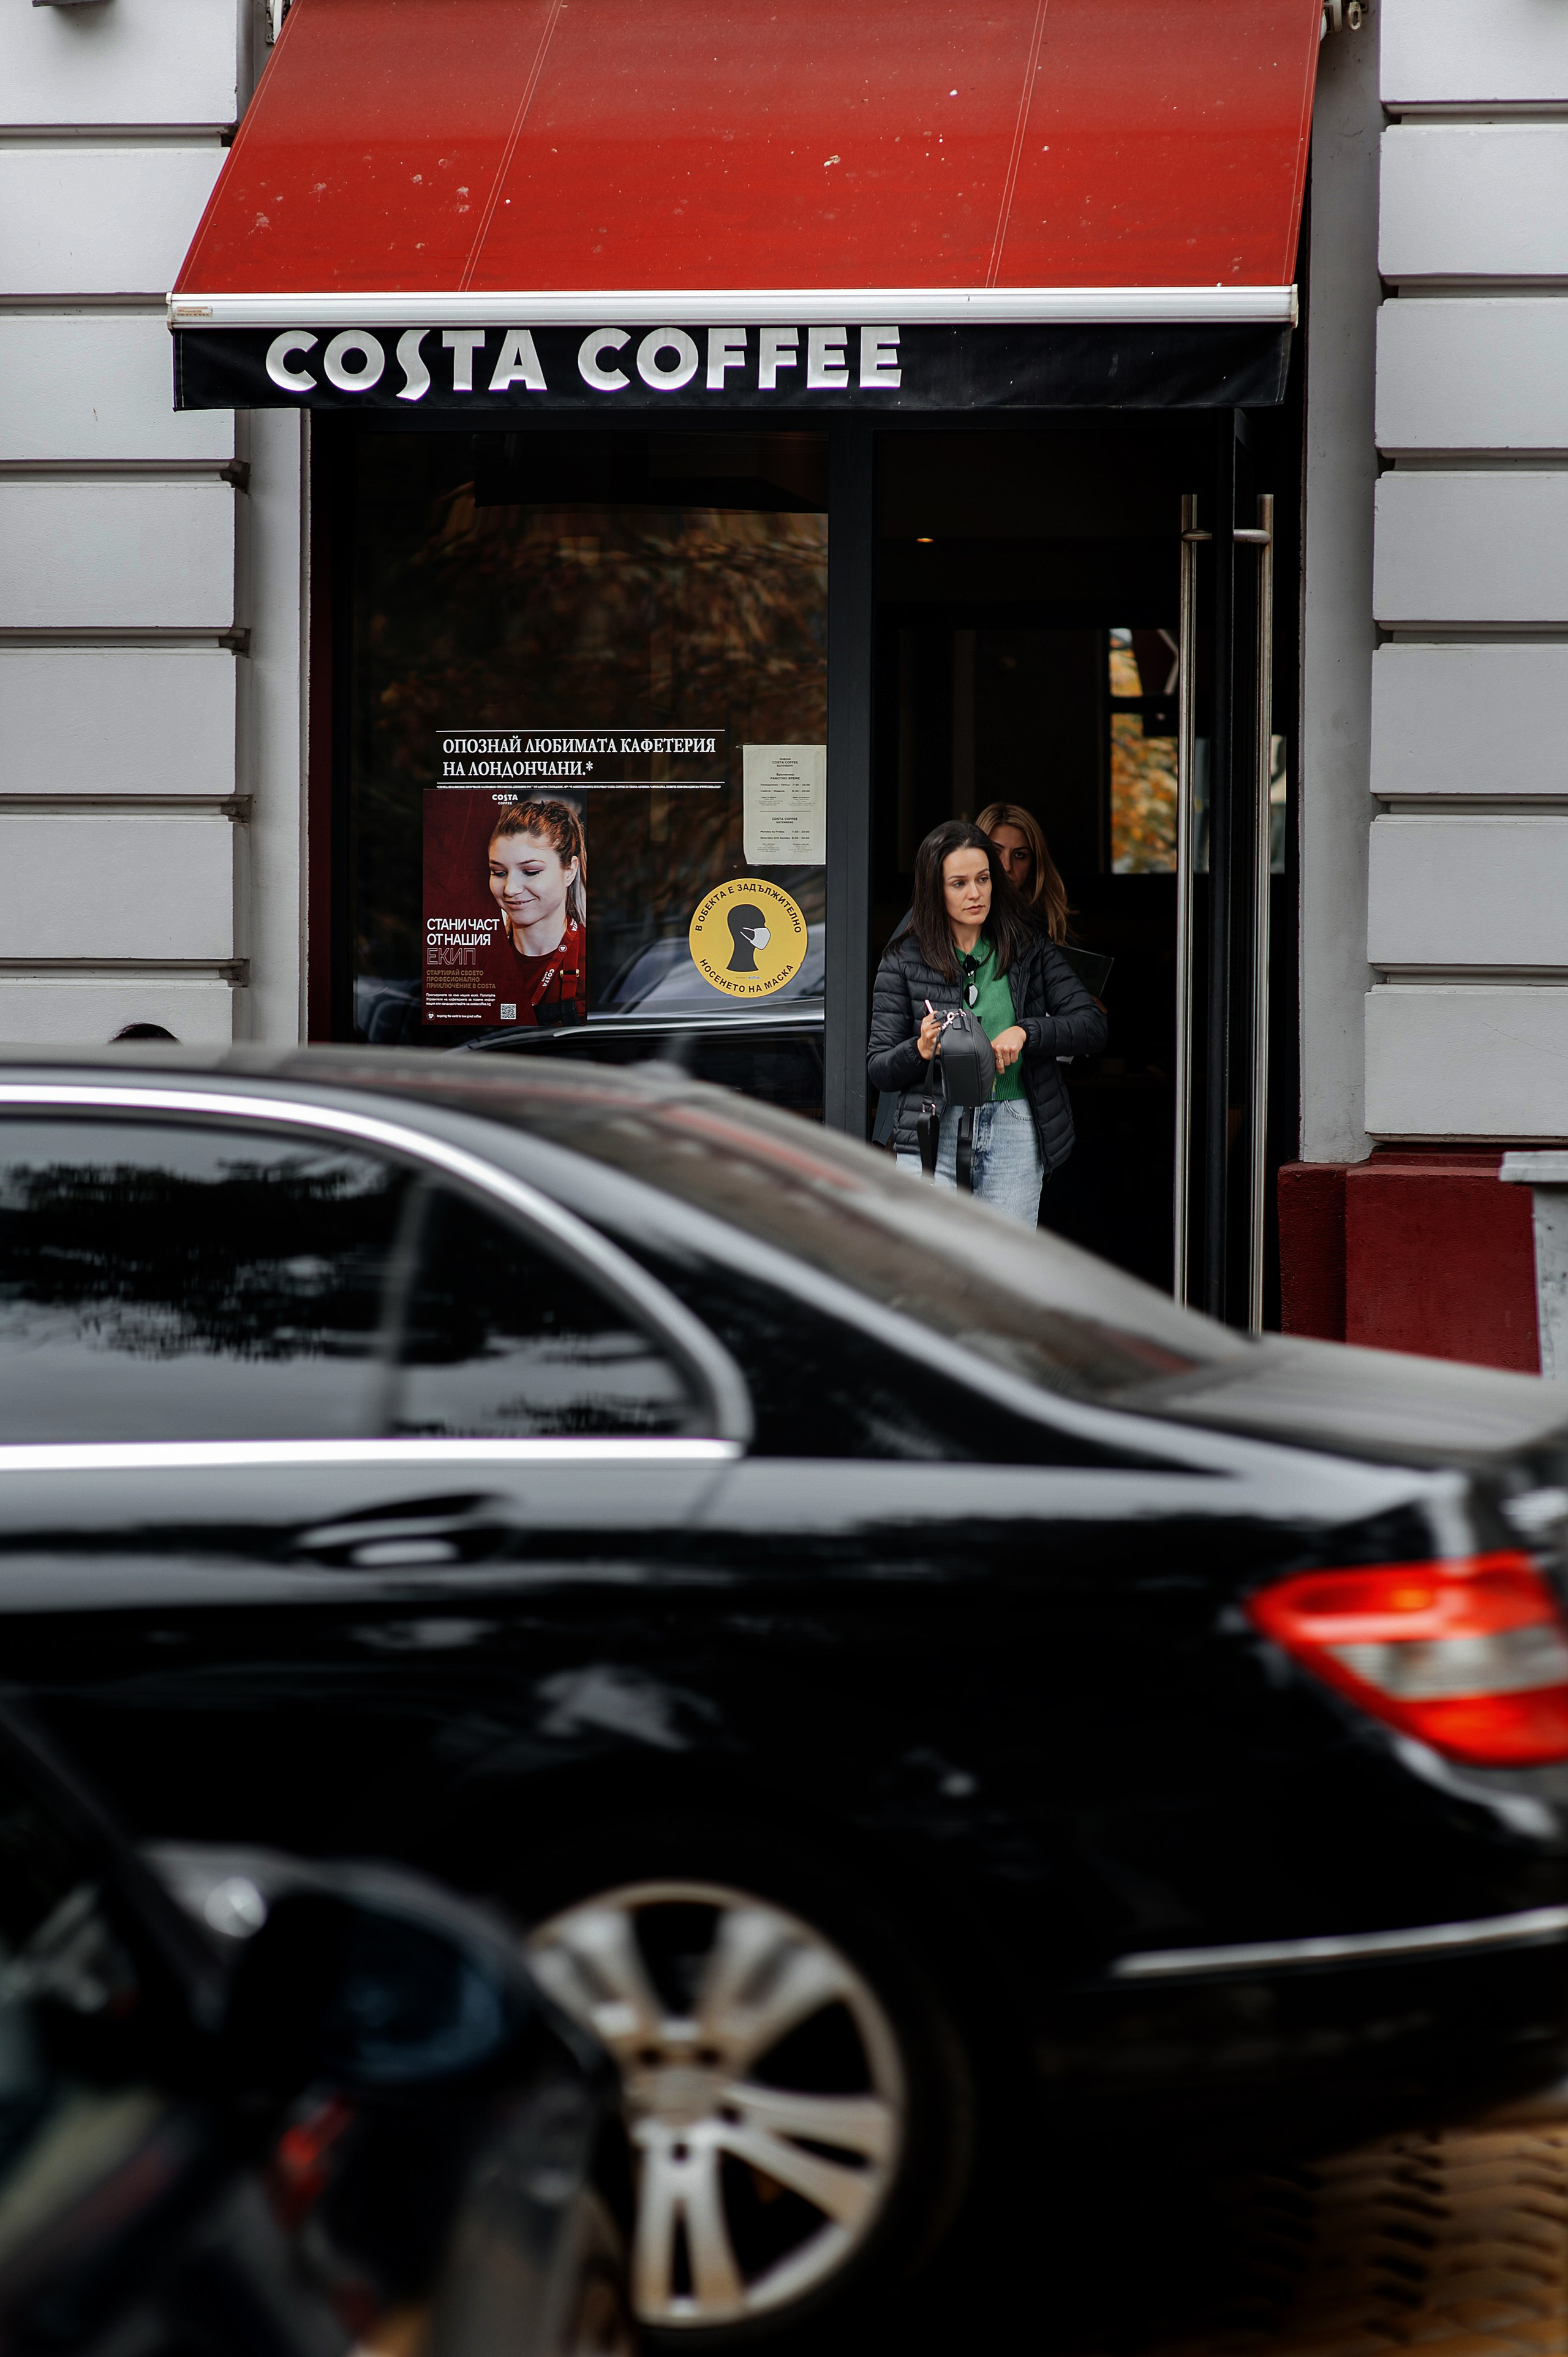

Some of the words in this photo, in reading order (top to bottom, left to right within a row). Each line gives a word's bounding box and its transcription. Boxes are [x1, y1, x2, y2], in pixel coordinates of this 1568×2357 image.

[266, 328, 548, 401] COSTA
[578, 327, 902, 391] COFFEE
[443, 735, 522, 753] ОПОЗНАЙ
[524, 738, 616, 753] ЛЮБИМАТА
[620, 738, 716, 753] КАФЕТЕРИЯ
[443, 762, 466, 776] НА
[698, 891, 727, 922] ОБЕКТА
[737, 883, 802, 933] ЗАДЪЛЖИТЕЛНО
[426, 918, 466, 931] СТАНИ
[468, 918, 500, 931] ЧАСТ
[426, 933, 443, 945] ОТ
[445, 933, 491, 945] НАШИЯ
[427, 947, 476, 965] ЕКИП
[542, 969, 554, 986] COSTA
[699, 959, 745, 993] НОСЕНЕТО
[764, 964, 793, 989] МАСКА
